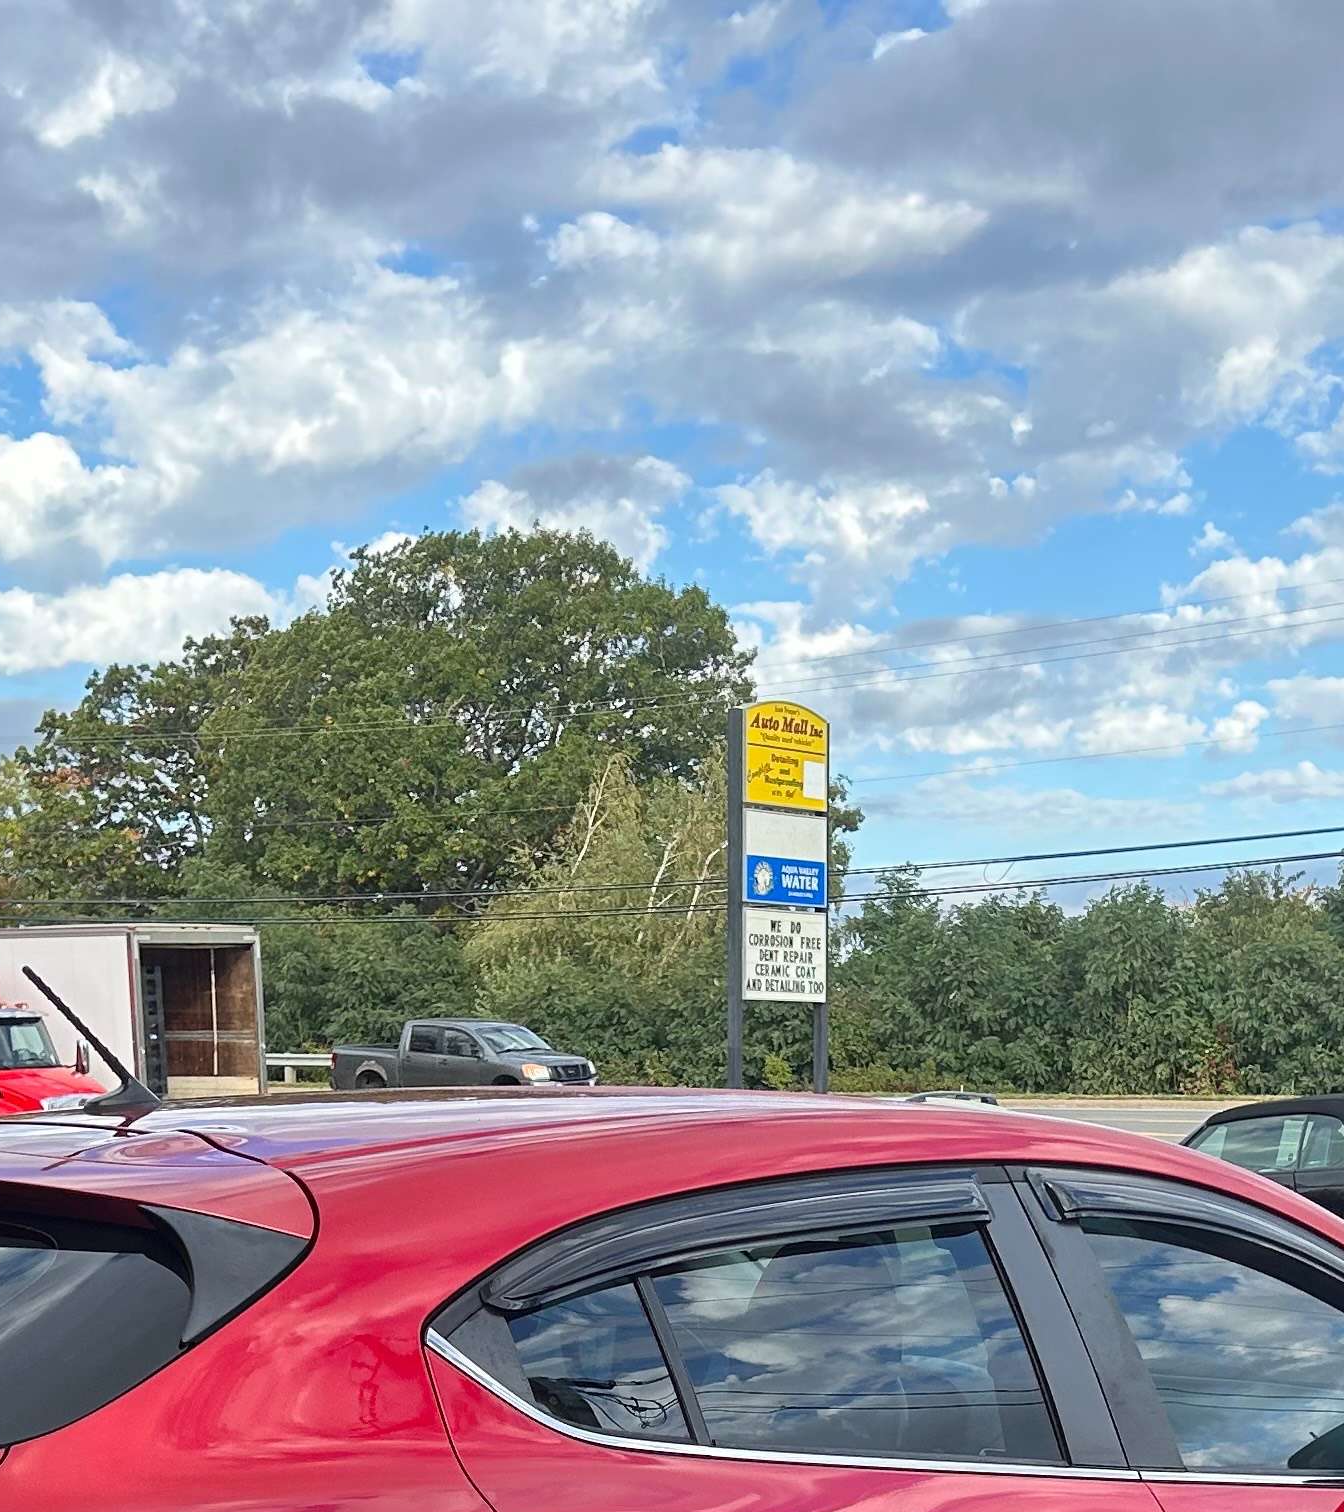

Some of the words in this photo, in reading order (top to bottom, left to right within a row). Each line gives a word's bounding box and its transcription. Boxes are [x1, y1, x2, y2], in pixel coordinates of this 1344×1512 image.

[750, 712, 779, 731] Auto
[781, 717, 808, 735] Mall
[809, 724, 824, 738] Inc
[781, 865, 798, 874] AQUA
[798, 866, 819, 876] VALLEY
[781, 874, 819, 891] WATER
[770, 920, 781, 933] WE
[790, 922, 801, 934] DO
[748, 933, 793, 948] CORROSION
[800, 937, 821, 950] FREE
[759, 949, 779, 962] DENT
[784, 951, 813, 964] REPAIR
[755, 964, 790, 978] CERAMIC
[796, 966, 816, 979] COAT
[746, 978, 762, 991] AND
[765, 979, 805, 993] DETAILING
[808, 981, 824, 994] TOO
